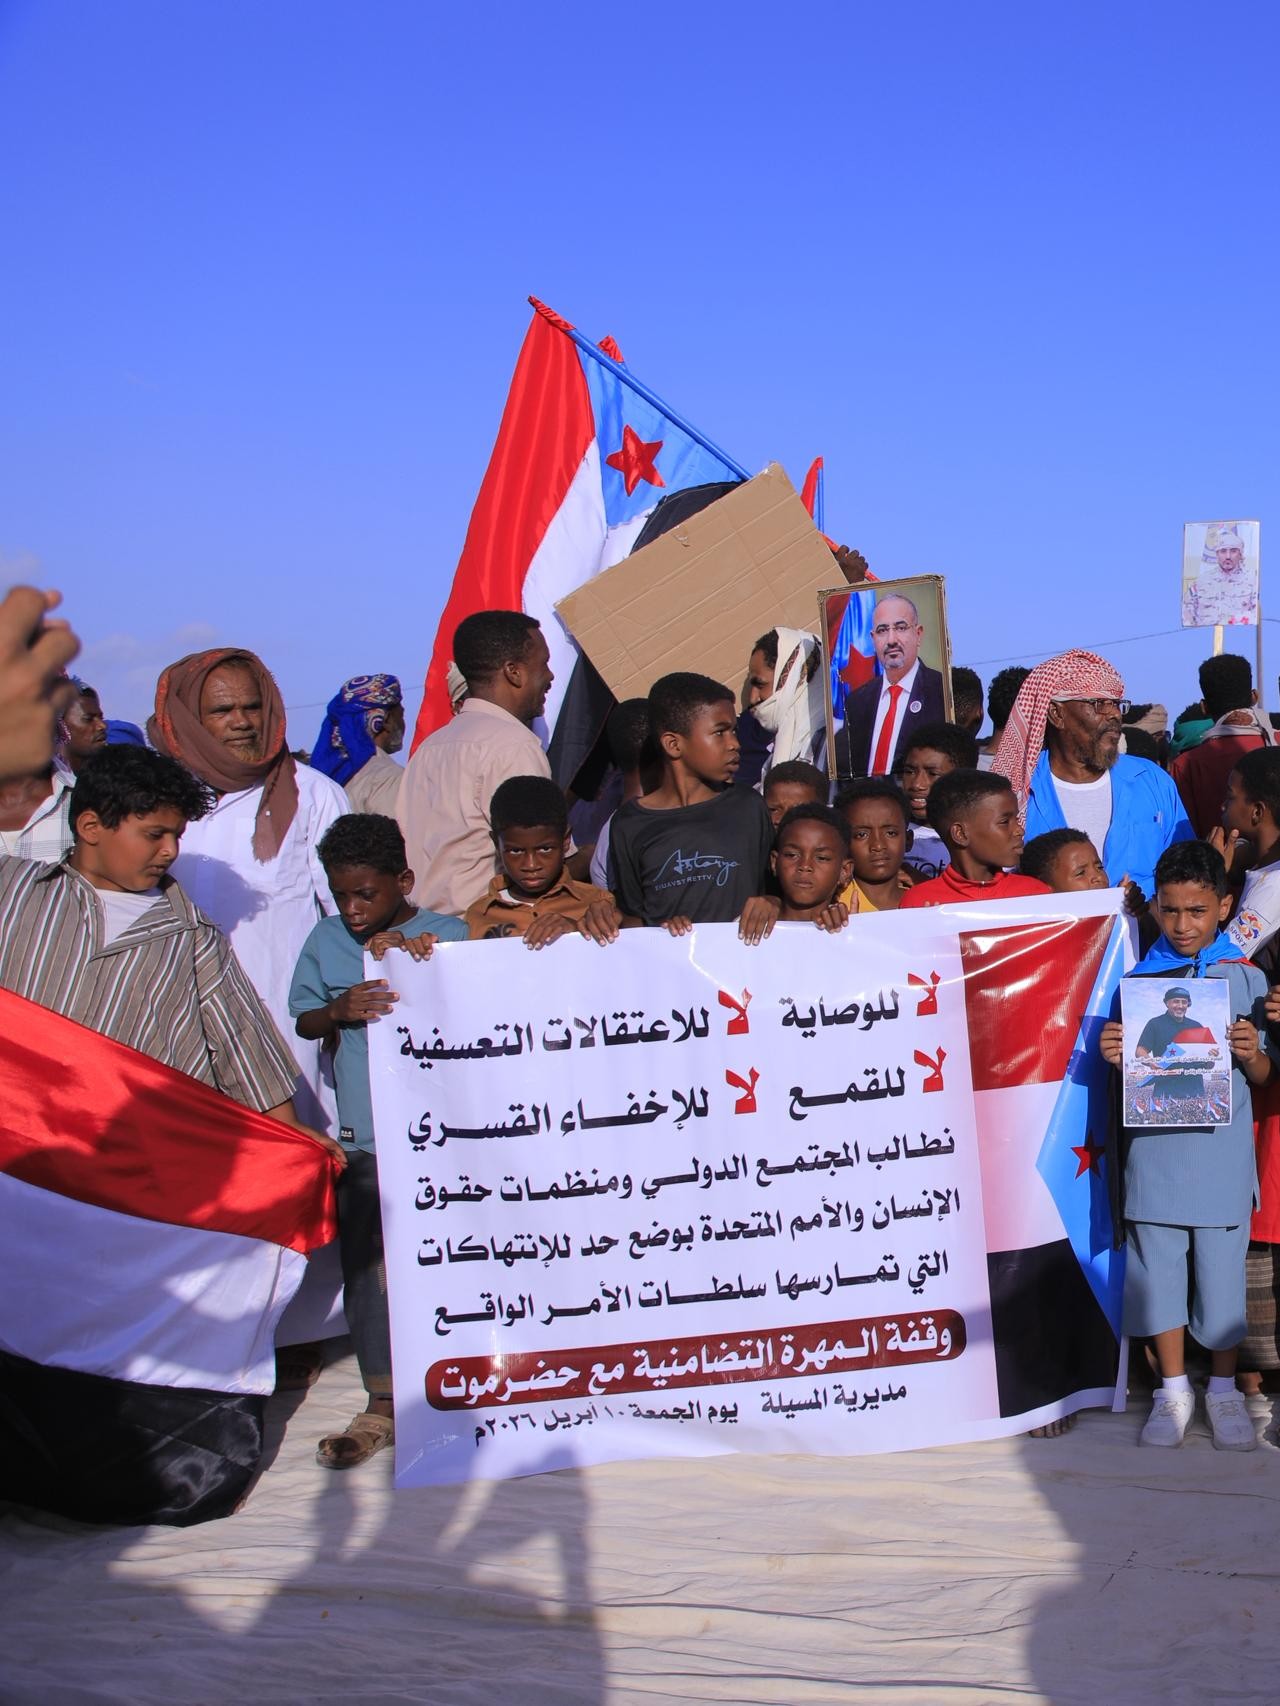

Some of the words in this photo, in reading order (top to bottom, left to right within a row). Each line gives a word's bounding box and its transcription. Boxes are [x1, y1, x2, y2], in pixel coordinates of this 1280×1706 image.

[1229, 925, 1248, 948] SPORT
[719, 988, 751, 1036] لا
[780, 989, 900, 1039] للوصاية
[908, 970, 941, 1016] لا
[397, 1023, 534, 1070] التعسفية
[543, 1007, 710, 1052] للاعتقالات
[726, 1068, 760, 1115] لا
[914, 1048, 947, 1093] لا
[561, 1087, 709, 1137] للإخفاء
[789, 1067, 906, 1121] للقمع
[409, 1103, 551, 1152] القسري
[868, 1128, 955, 1169] نطالب
[500, 1169, 633, 1202] ومنظمات
[642, 1154, 748, 1200] الدولي
[757, 1141, 860, 1188] المجتمع
[415, 1176, 493, 1211] حقوق
[873, 1188, 961, 1230] الإنسان
[629, 1221, 695, 1260] بوضع
[700, 1211, 783, 1242] المتحدة
[790, 1199, 864, 1241] والأمم
[418, 1234, 571, 1268] للإنتهاكات
[581, 1235, 620, 1257] حد
[639, 1275, 767, 1308] سلطات
[776, 1255, 900, 1301] تمارسها
[908, 1250, 949, 1295] التي
[435, 1293, 534, 1337] الواقع
[541, 1284, 632, 1326] الأمر
[781, 1326, 880, 1372] المهرة
[884, 1317, 953, 1357] وقفة
[440, 1362, 580, 1405] حضرموت
[588, 1363, 625, 1395] مع
[634, 1338, 775, 1389] التضامنية
[544, 1406, 598, 1432] أبريل
[629, 1401, 702, 1424] الجمعة
[708, 1403, 739, 1425] يوم
[761, 1389, 828, 1419] المسيلة
[833, 1384, 907, 1413] مديرية
